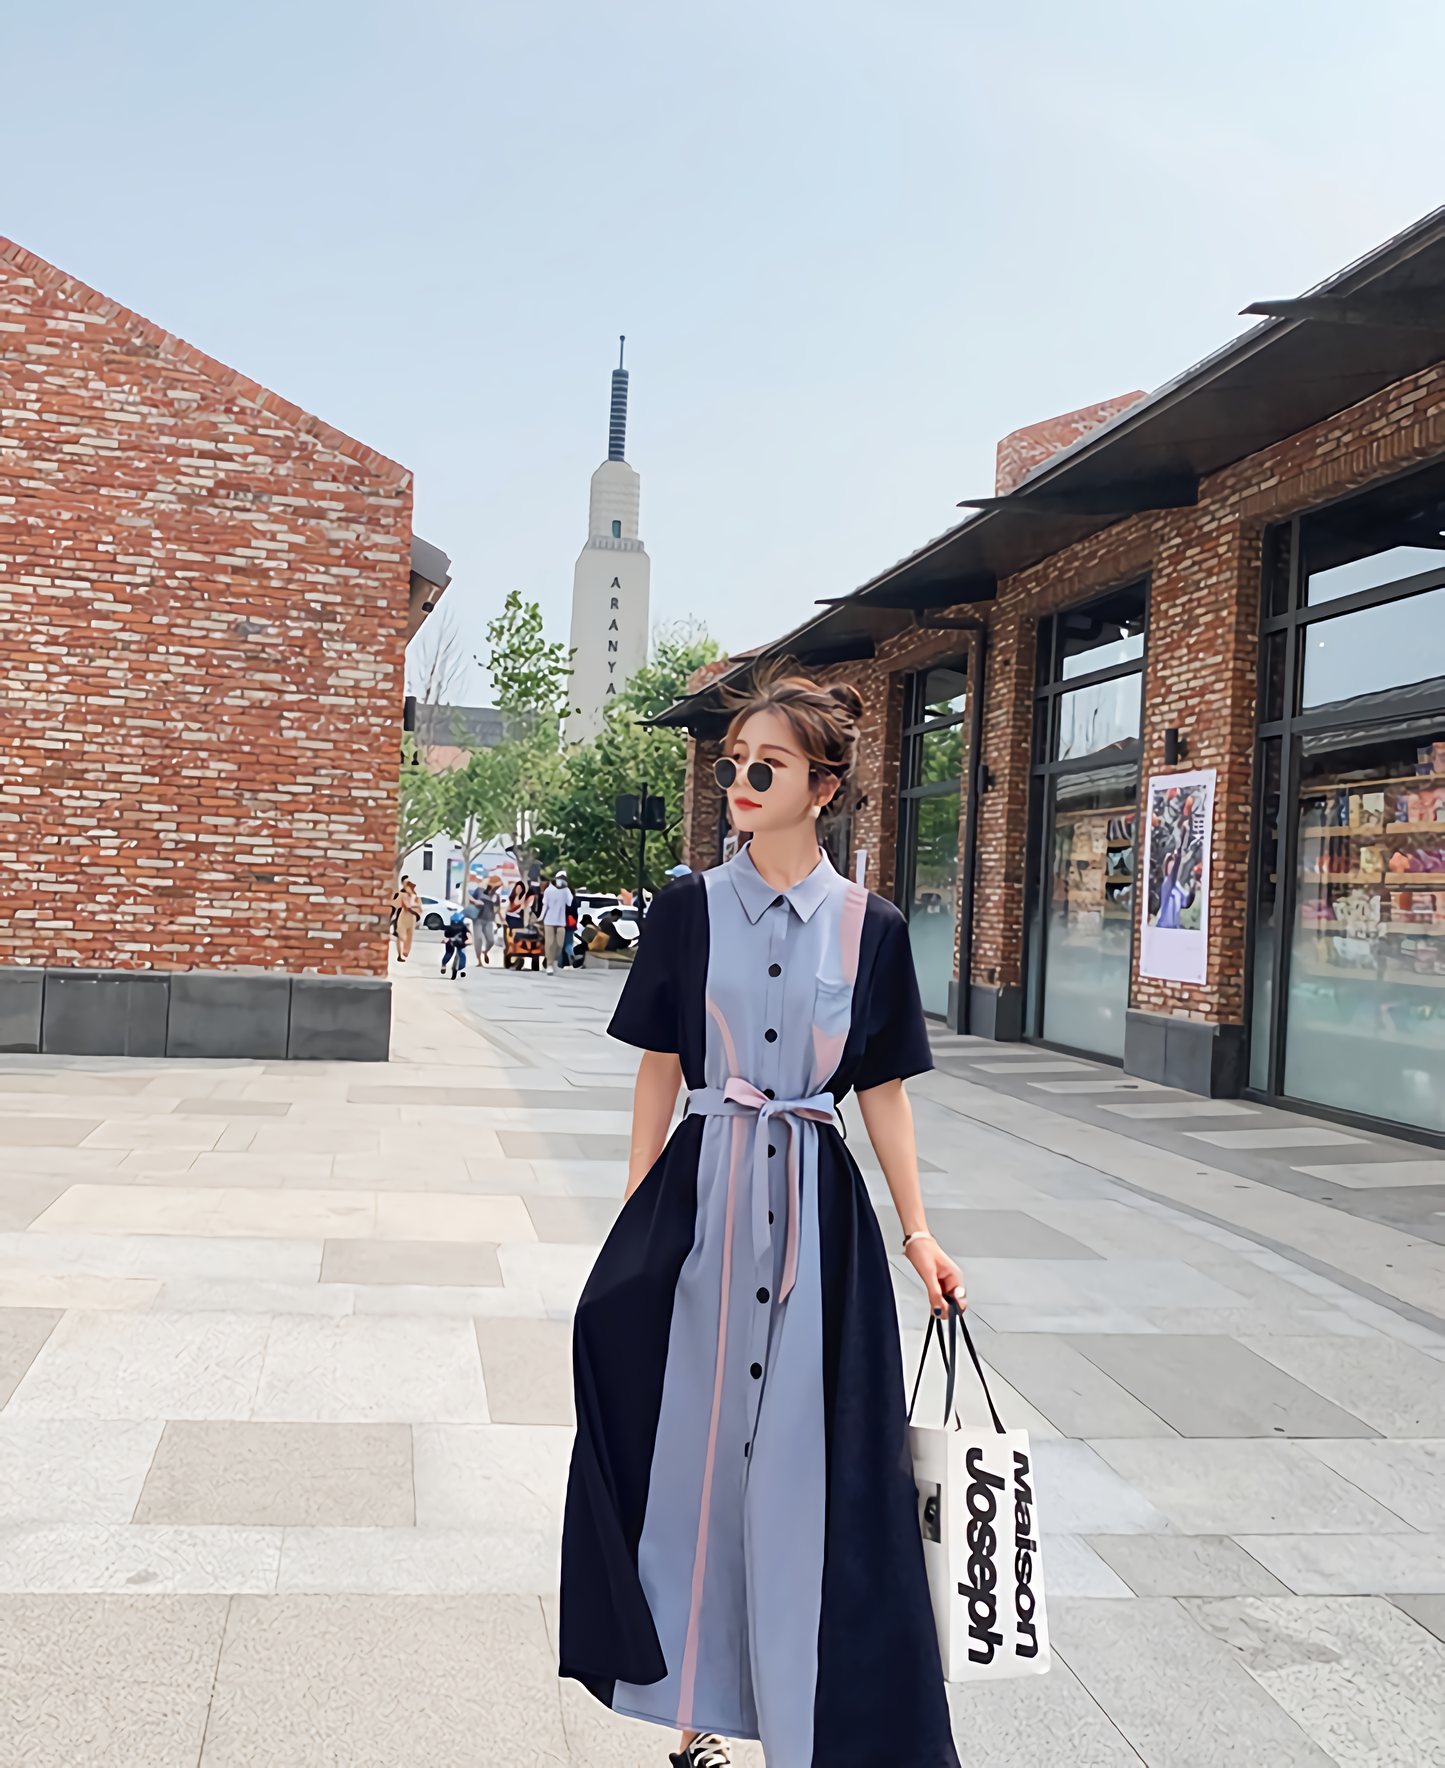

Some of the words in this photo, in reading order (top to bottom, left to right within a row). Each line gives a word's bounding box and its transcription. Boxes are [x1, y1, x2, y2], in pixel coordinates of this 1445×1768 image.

[605, 576, 621, 695] ARANYA
[957, 1446, 1006, 1665] Joseph
[1012, 1450, 1039, 1659] Maison
